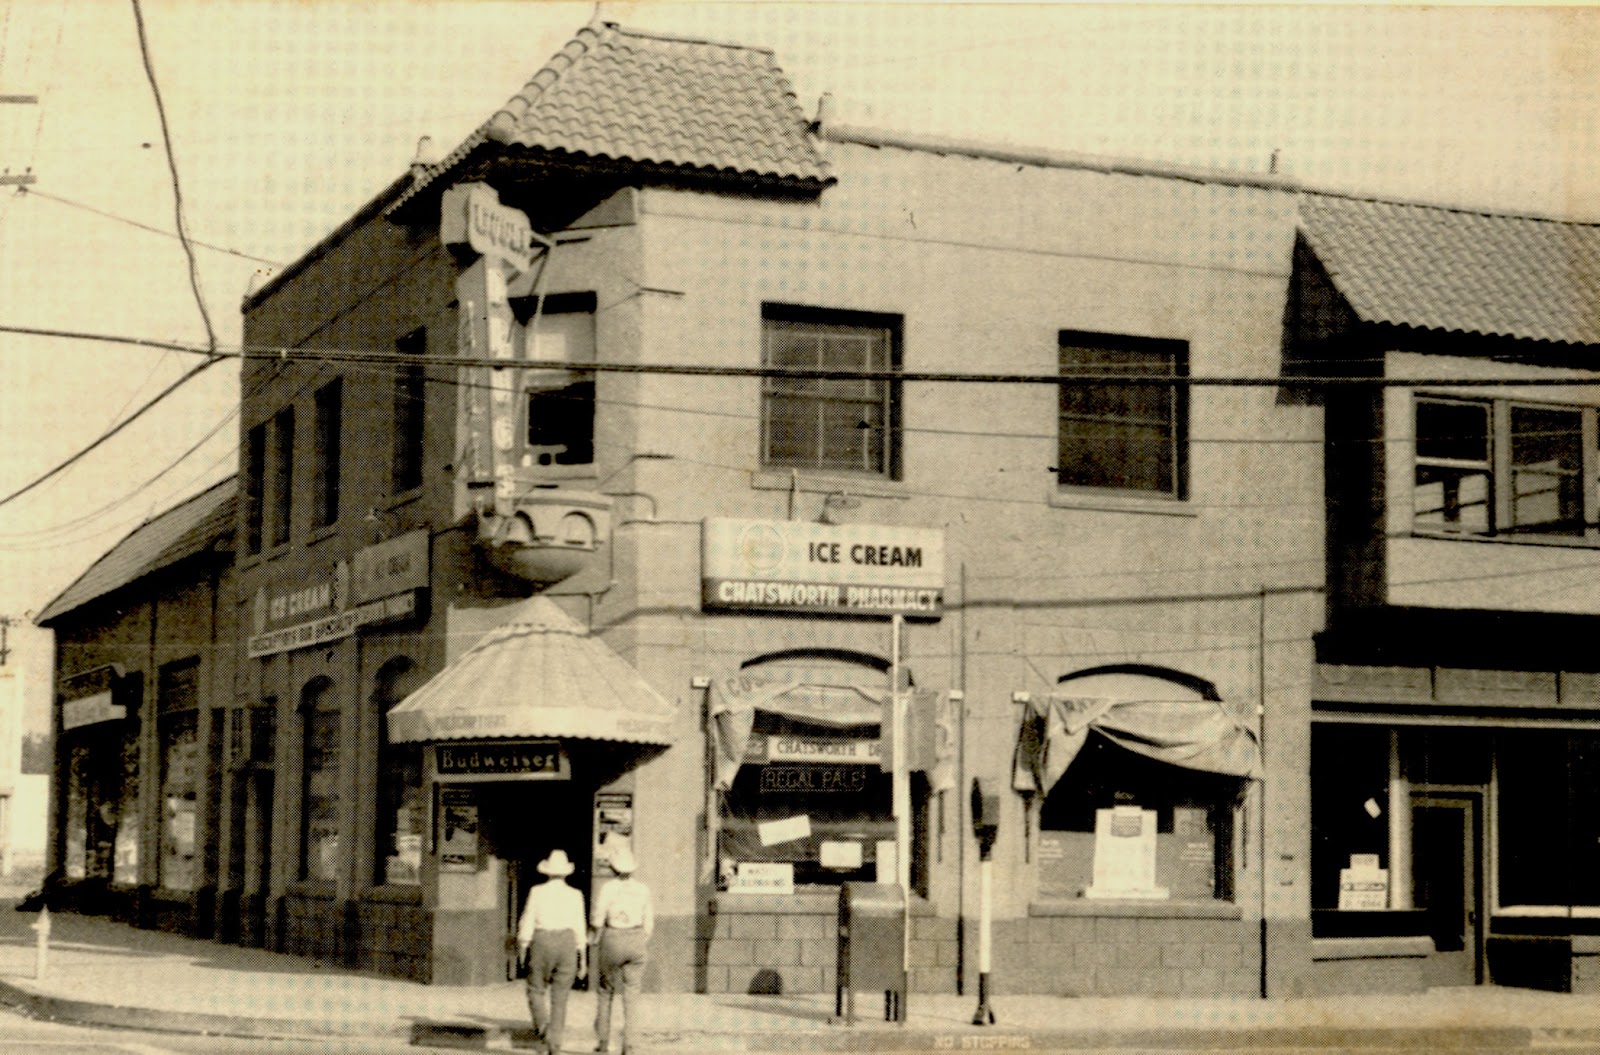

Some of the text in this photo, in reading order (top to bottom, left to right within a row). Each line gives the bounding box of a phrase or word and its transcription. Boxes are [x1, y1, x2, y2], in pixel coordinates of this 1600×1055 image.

[809, 542, 922, 568] ICE CREAM
[718, 581, 939, 611] CHATSWORTH PHARMACY
[442, 748, 555, 768] Budweiser
[777, 740, 857, 756] CHATSWORTH
[766, 770, 815, 790] REGAL
[961, 1035, 1032, 1050] STOPPING
